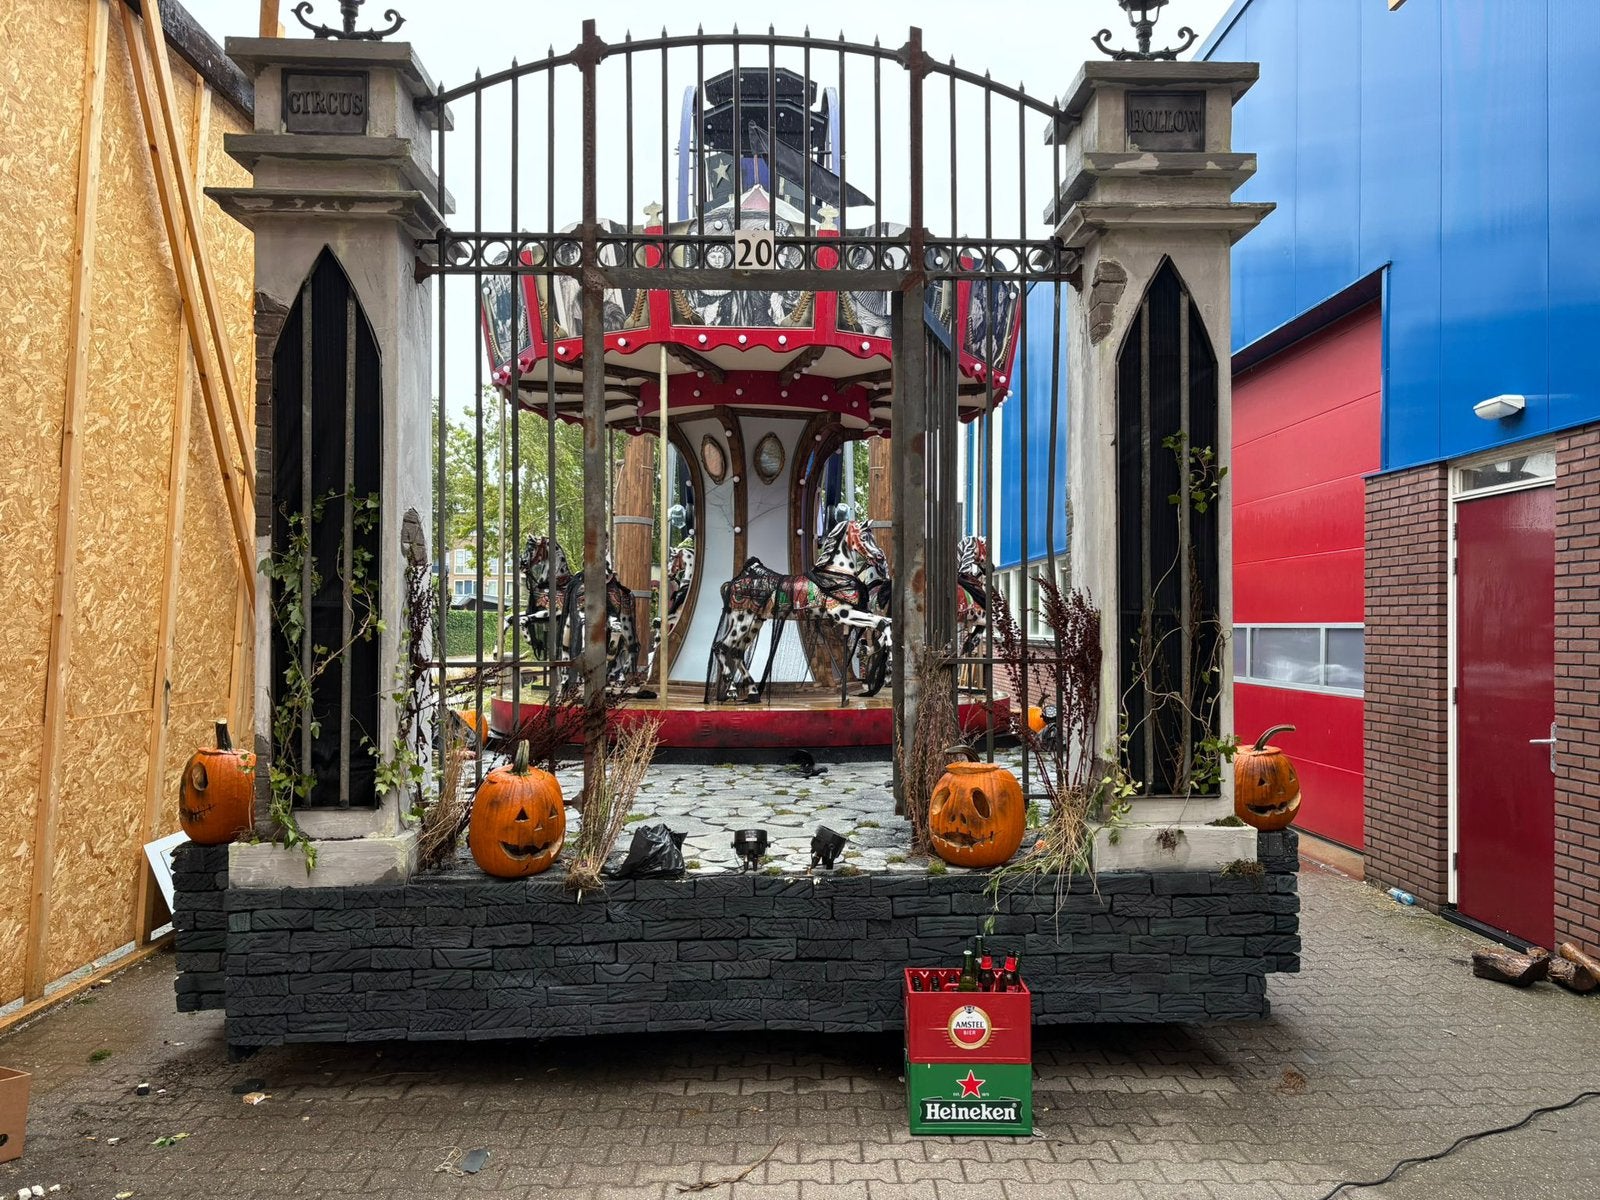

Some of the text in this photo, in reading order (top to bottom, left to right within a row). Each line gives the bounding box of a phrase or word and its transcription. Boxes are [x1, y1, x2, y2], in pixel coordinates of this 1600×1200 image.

[289, 91, 363, 115] CIRCUS
[1130, 110, 1201, 132] HOLLOW
[738, 239, 772, 266] 20
[926, 1103, 1016, 1120] Heineken
